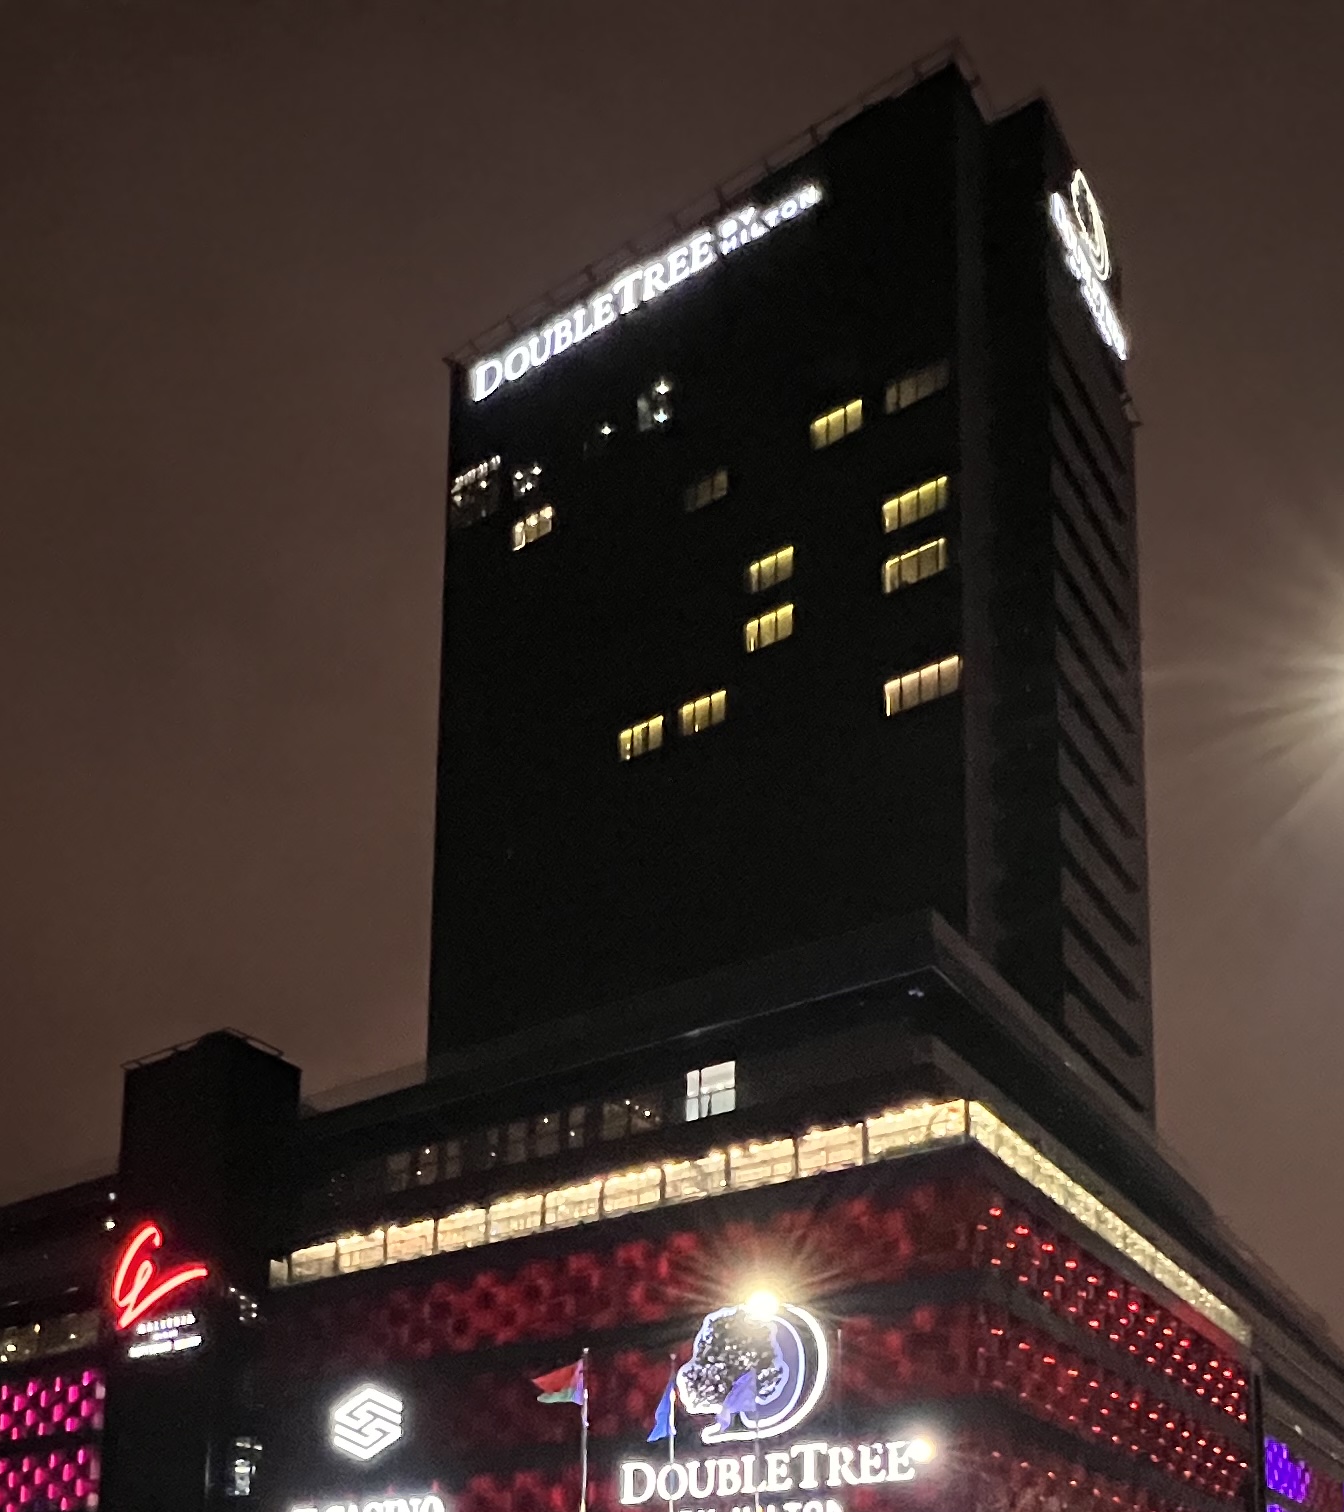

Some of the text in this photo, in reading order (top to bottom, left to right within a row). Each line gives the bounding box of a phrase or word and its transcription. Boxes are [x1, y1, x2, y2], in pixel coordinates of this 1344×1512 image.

[720, 184, 821, 255] HILTON
[470, 205, 756, 402] DOUBLETREE BY
[620, 1441, 917, 1505] DOUBLETREE
